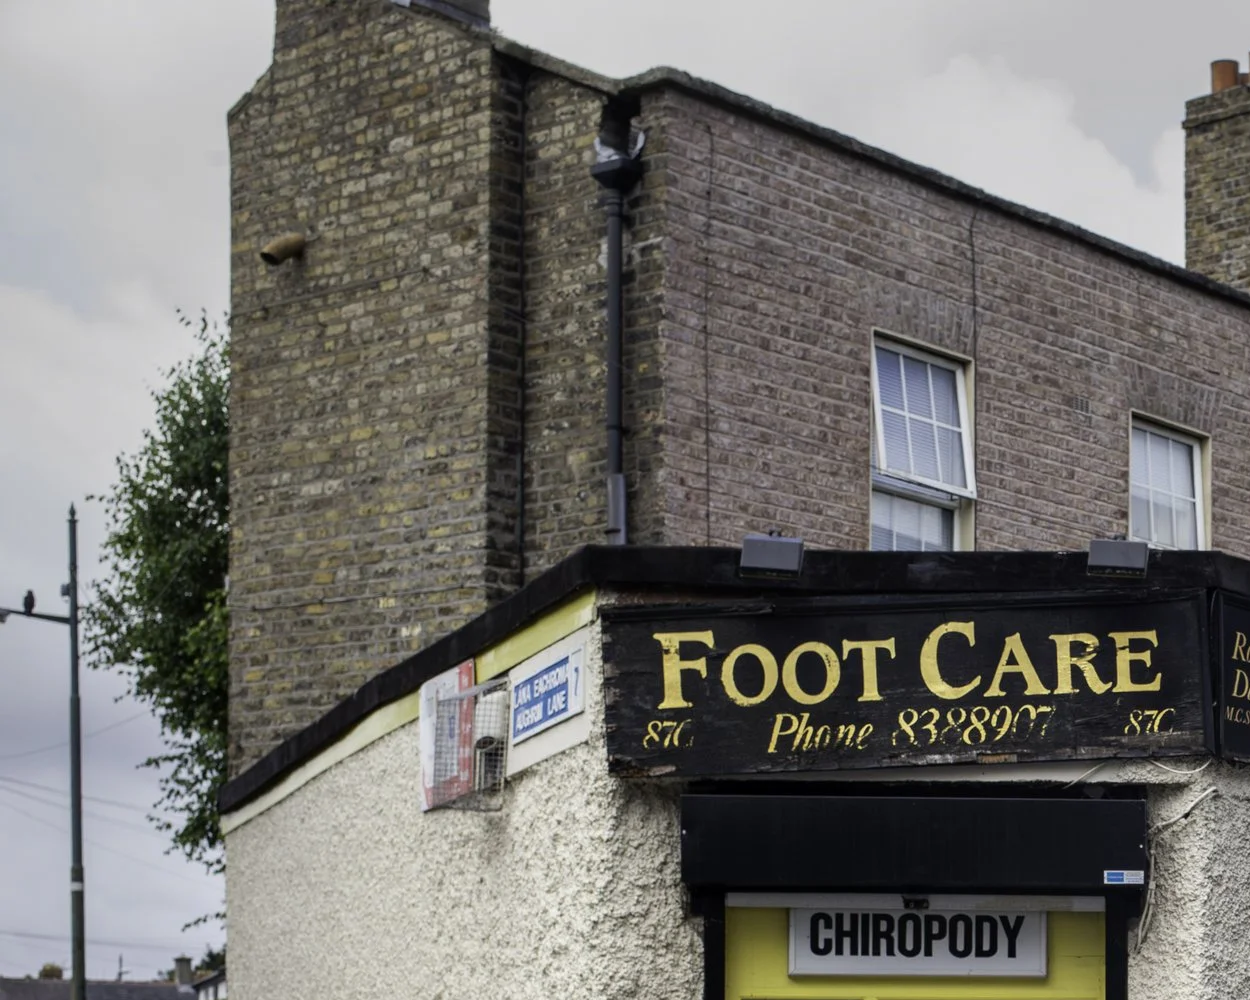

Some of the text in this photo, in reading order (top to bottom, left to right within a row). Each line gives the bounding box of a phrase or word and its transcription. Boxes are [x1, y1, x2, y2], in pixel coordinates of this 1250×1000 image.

[651, 620, 1163, 709] FOOT CARE
[547, 691, 567, 716] LANE
[766, 704, 1057, 754] Phone 8388907
[809, 911, 1026, 960] CHIROPODY
